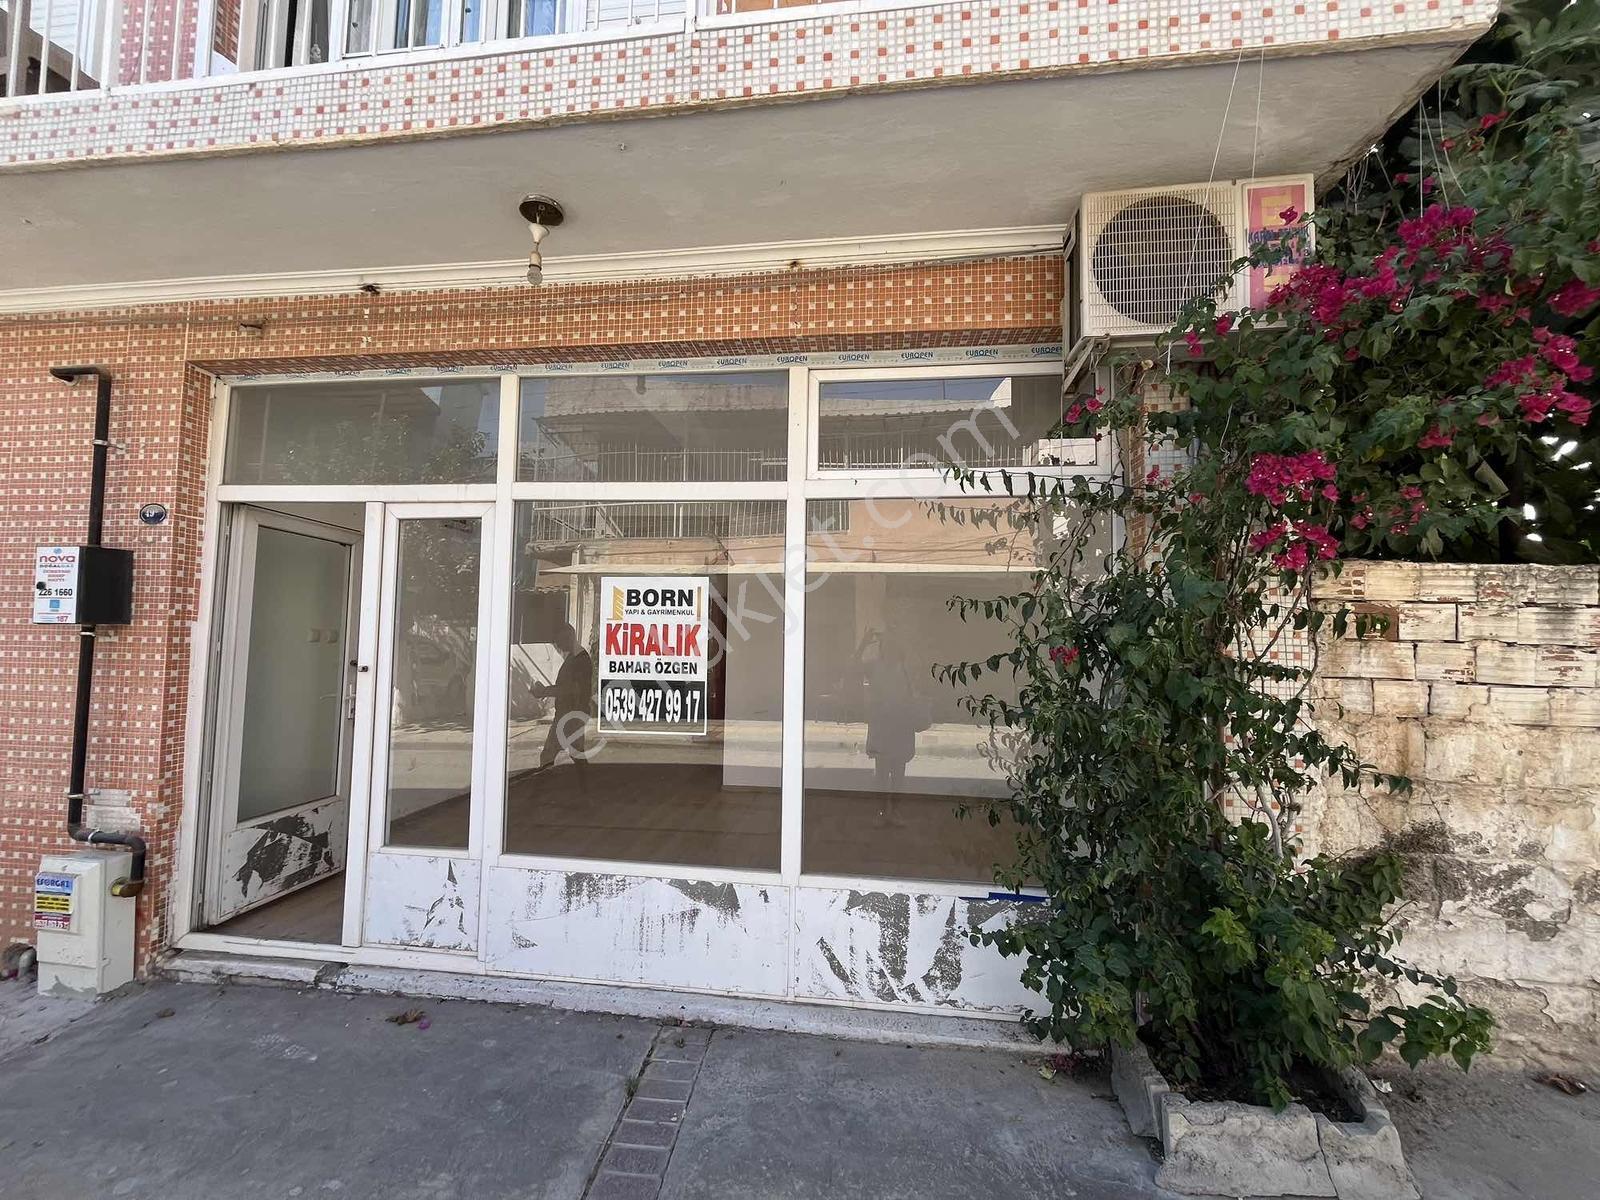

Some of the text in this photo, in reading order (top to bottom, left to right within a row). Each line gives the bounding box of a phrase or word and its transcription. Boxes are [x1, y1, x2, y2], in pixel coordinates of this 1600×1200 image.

[39, 555, 76, 563] nova
[626, 588, 694, 607] BORN
[647, 608, 695, 616] GAYRİMENKUL
[609, 658, 698, 675] BAHAR ÖZGEN
[605, 687, 701, 723] 0539 427 99 17
